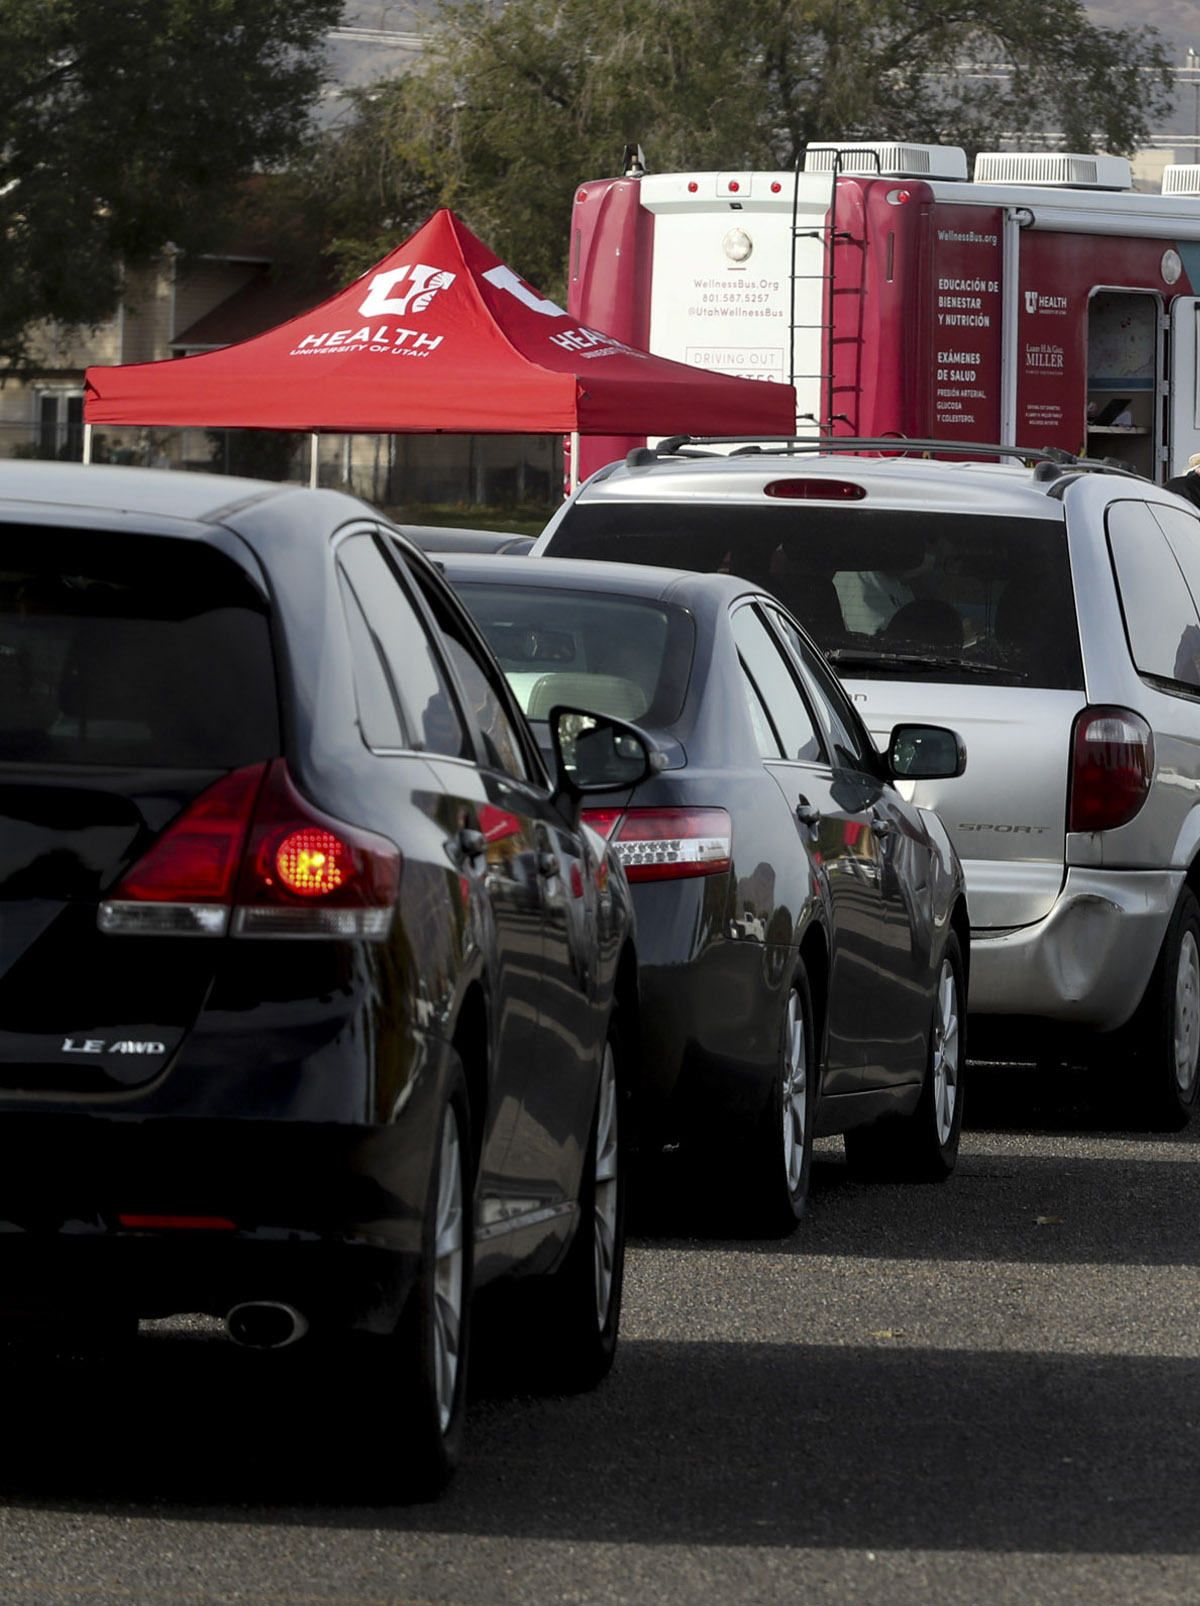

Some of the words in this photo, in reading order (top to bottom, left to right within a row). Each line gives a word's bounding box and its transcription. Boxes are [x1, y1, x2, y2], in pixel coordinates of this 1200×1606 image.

[938, 230, 997, 246] WellnessBus.org
[694, 279, 779, 291] WellnessBus.Org
[938, 277, 986, 291] EDUCACIÓN
[988, 281, 999, 292] DE
[702, 293, 769, 303] 801.587.5257
[938, 296, 982, 309] BIENESTAR
[1038, 296, 1067, 308] HEALTH
[688, 307, 783, 317] @UtahWellnessBus
[938, 314, 944, 325] Y
[946, 312, 990, 327] NUTRICIÓN
[298, 326, 444, 350] HEALTH
[289, 344, 368, 356] UNIVERSITY
[369, 345, 390, 353] OF
[392, 347, 429, 358] UTAH
[937, 348, 981, 364] EXÁMENES
[694, 353, 745, 364] DRIVING
[750, 353, 776, 365] OUT
[1026, 353, 1064, 368] MILLER
[937, 369, 948, 380] DE
[950, 370, 976, 381] SALUD
[957, 822, 1051, 834] SPORT
[62, 1038, 105, 1053] LE
[109, 1040, 166, 1054] AWD
